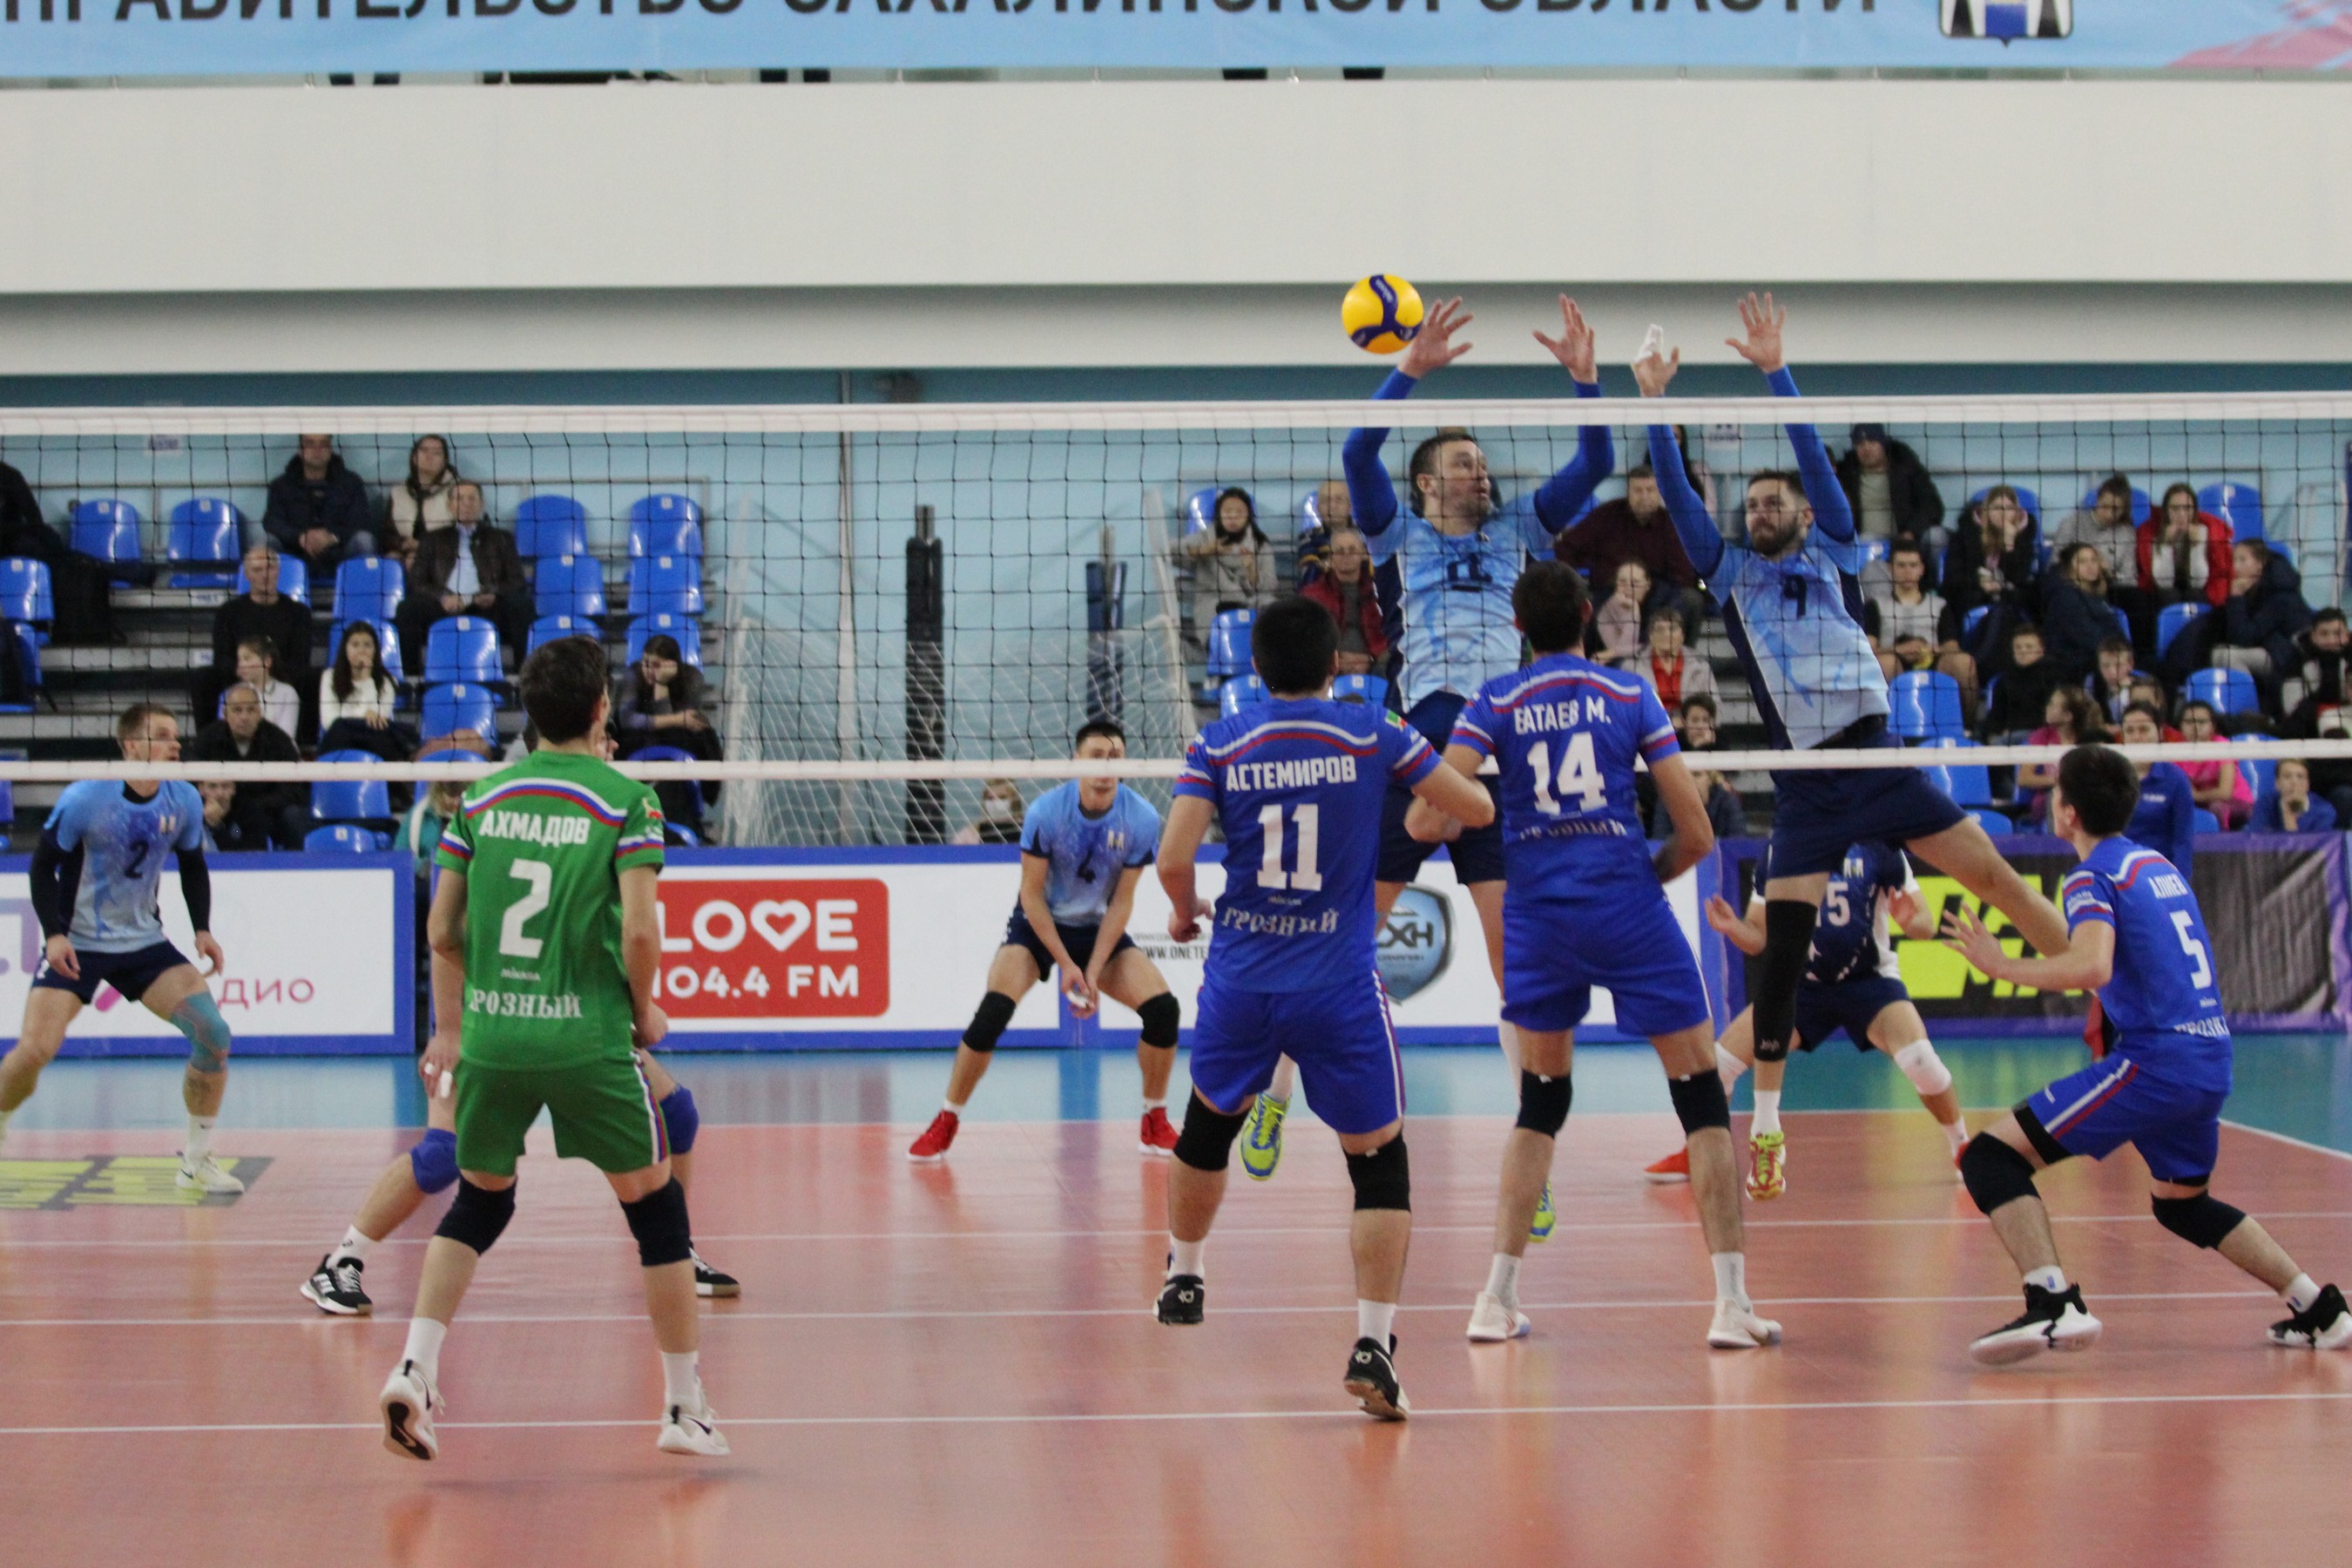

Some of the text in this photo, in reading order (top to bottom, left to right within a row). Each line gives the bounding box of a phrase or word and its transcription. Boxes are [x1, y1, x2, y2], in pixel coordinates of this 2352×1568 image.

[1226, 754, 1357, 792] АСТЕМИРОВ
[1527, 732, 1608, 816] 14
[478, 809, 591, 848] АХМАДОВ
[1257, 803, 1322, 891] 11
[125, 841, 149, 879] 2
[499, 858, 552, 958] 2
[2169, 909, 2212, 990] 5
[787, 964, 859, 998] FM
[469, 989, 584, 1019] РОЗНЫЙ
